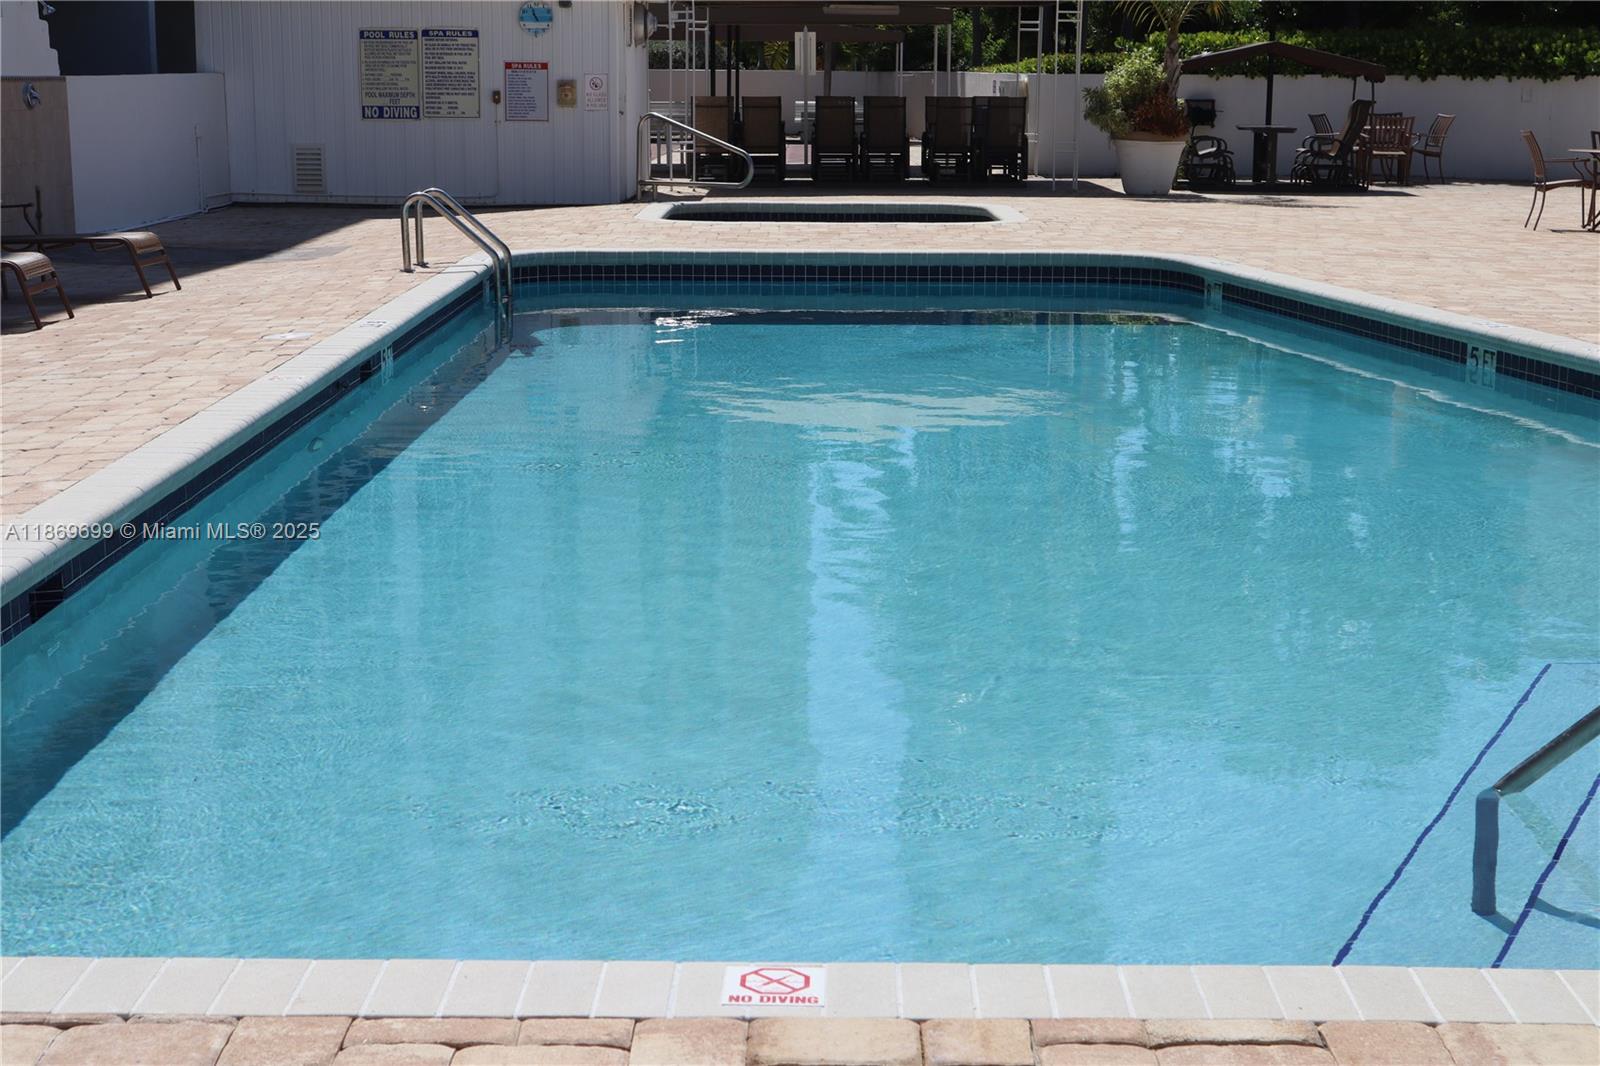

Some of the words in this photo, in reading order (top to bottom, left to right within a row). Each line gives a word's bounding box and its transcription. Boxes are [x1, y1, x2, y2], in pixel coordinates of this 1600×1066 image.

[364, 106, 380, 118] NO
[383, 106, 418, 118] DIVING
[728, 995, 752, 1003] NO
[759, 995, 819, 1004] DIVING
